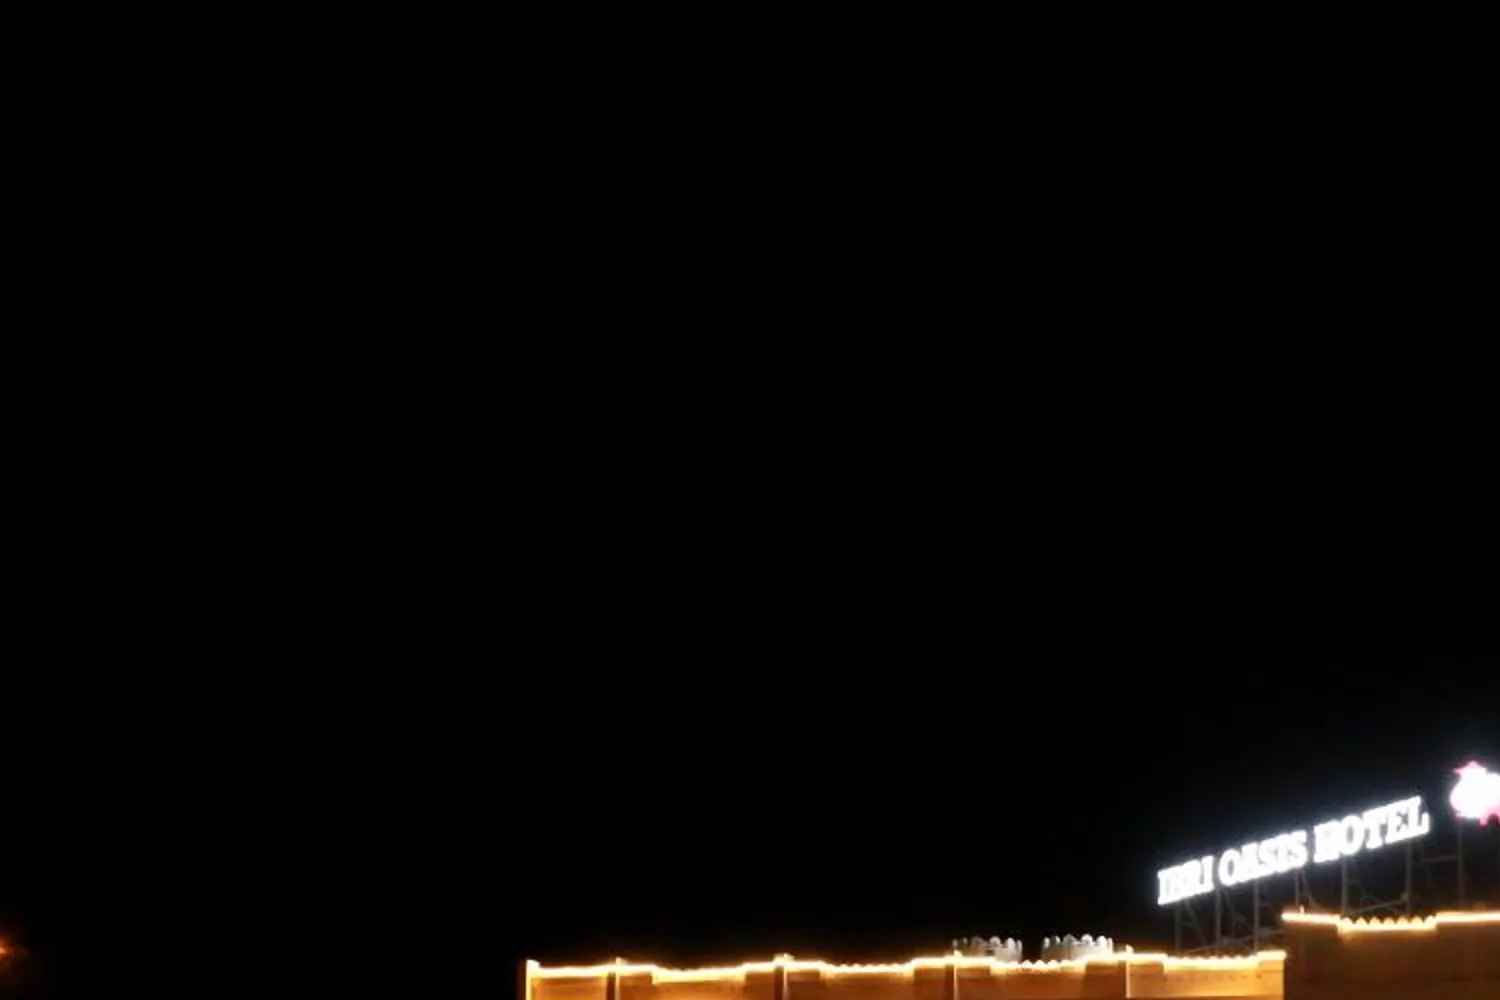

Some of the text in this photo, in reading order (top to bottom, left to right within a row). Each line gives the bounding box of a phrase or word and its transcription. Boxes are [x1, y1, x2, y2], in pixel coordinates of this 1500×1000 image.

[1157, 795, 1430, 905] IBRI OASIS HOTEL
